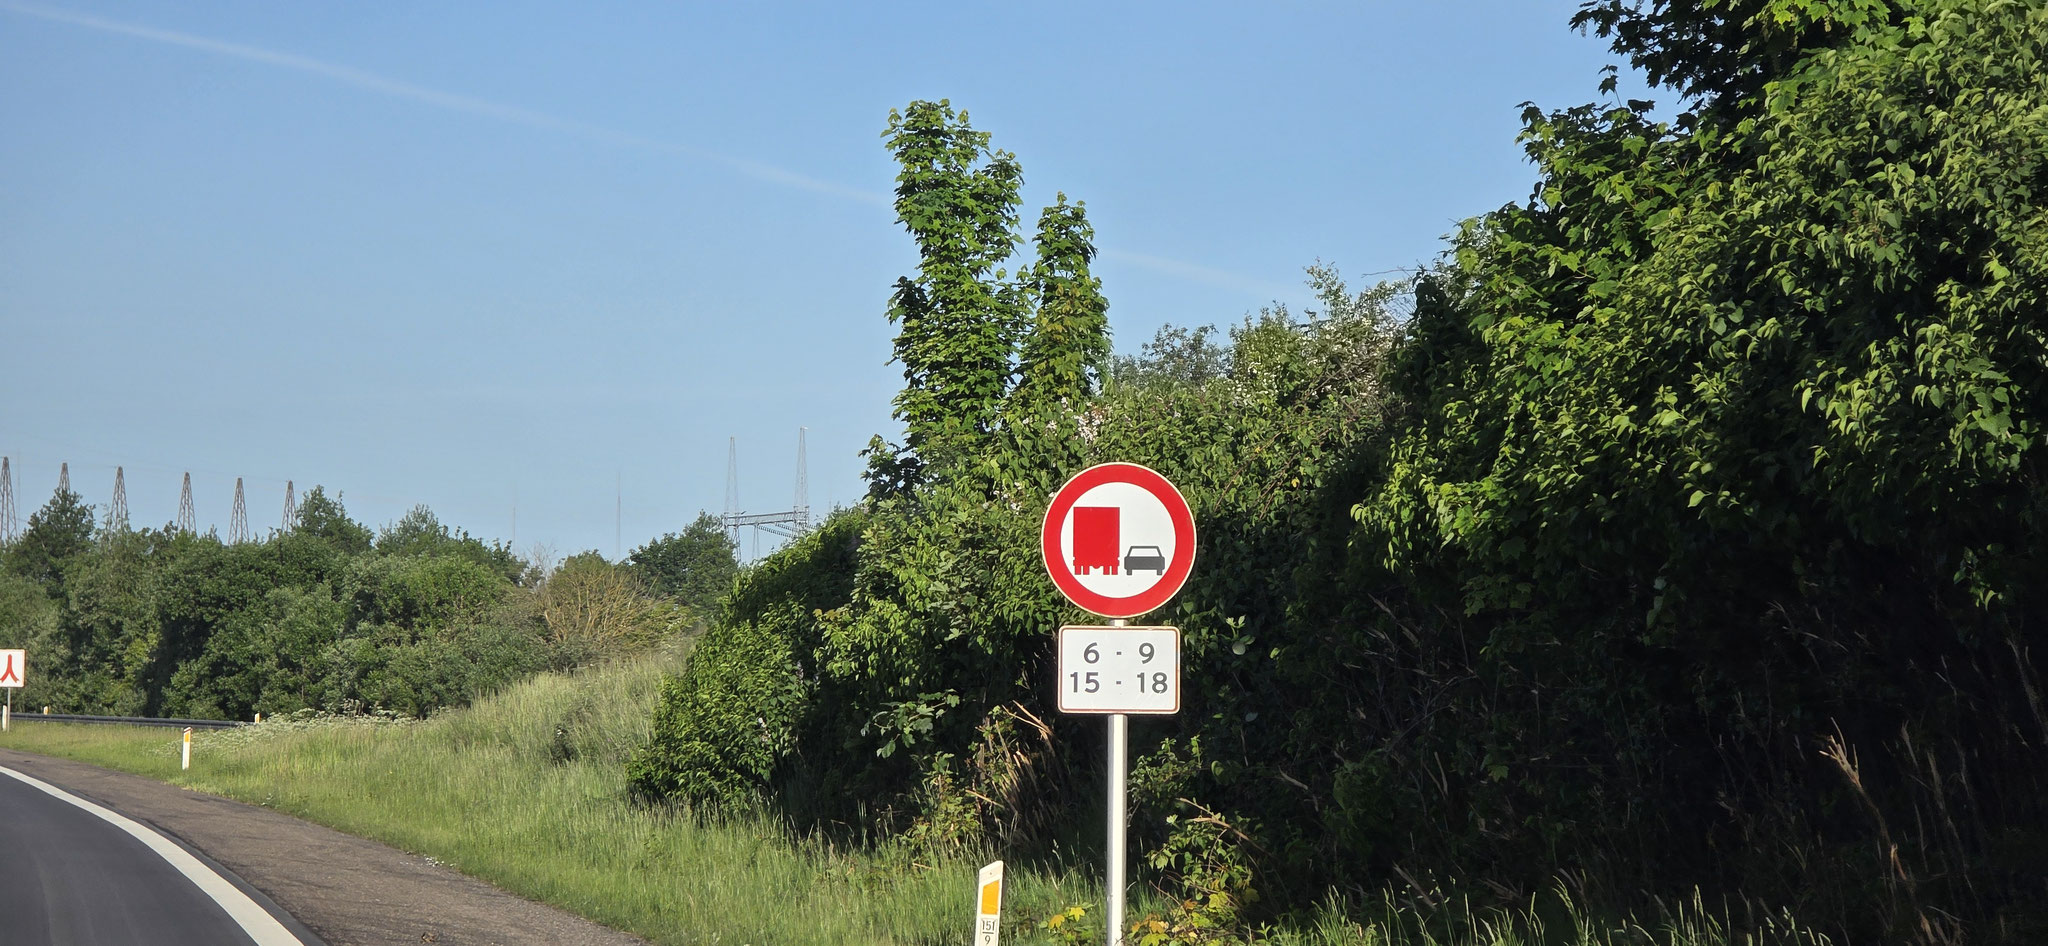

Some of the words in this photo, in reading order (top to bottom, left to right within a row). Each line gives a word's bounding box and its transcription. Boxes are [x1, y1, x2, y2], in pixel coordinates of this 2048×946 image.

[1083, 642, 1100, 664] 6
[1138, 642, 1155, 664] 9
[1070, 672, 1100, 693] 15
[1137, 672, 1168, 694] 18
[981, 920, 996, 931] 151
[984, 935, 991, 945] 9
